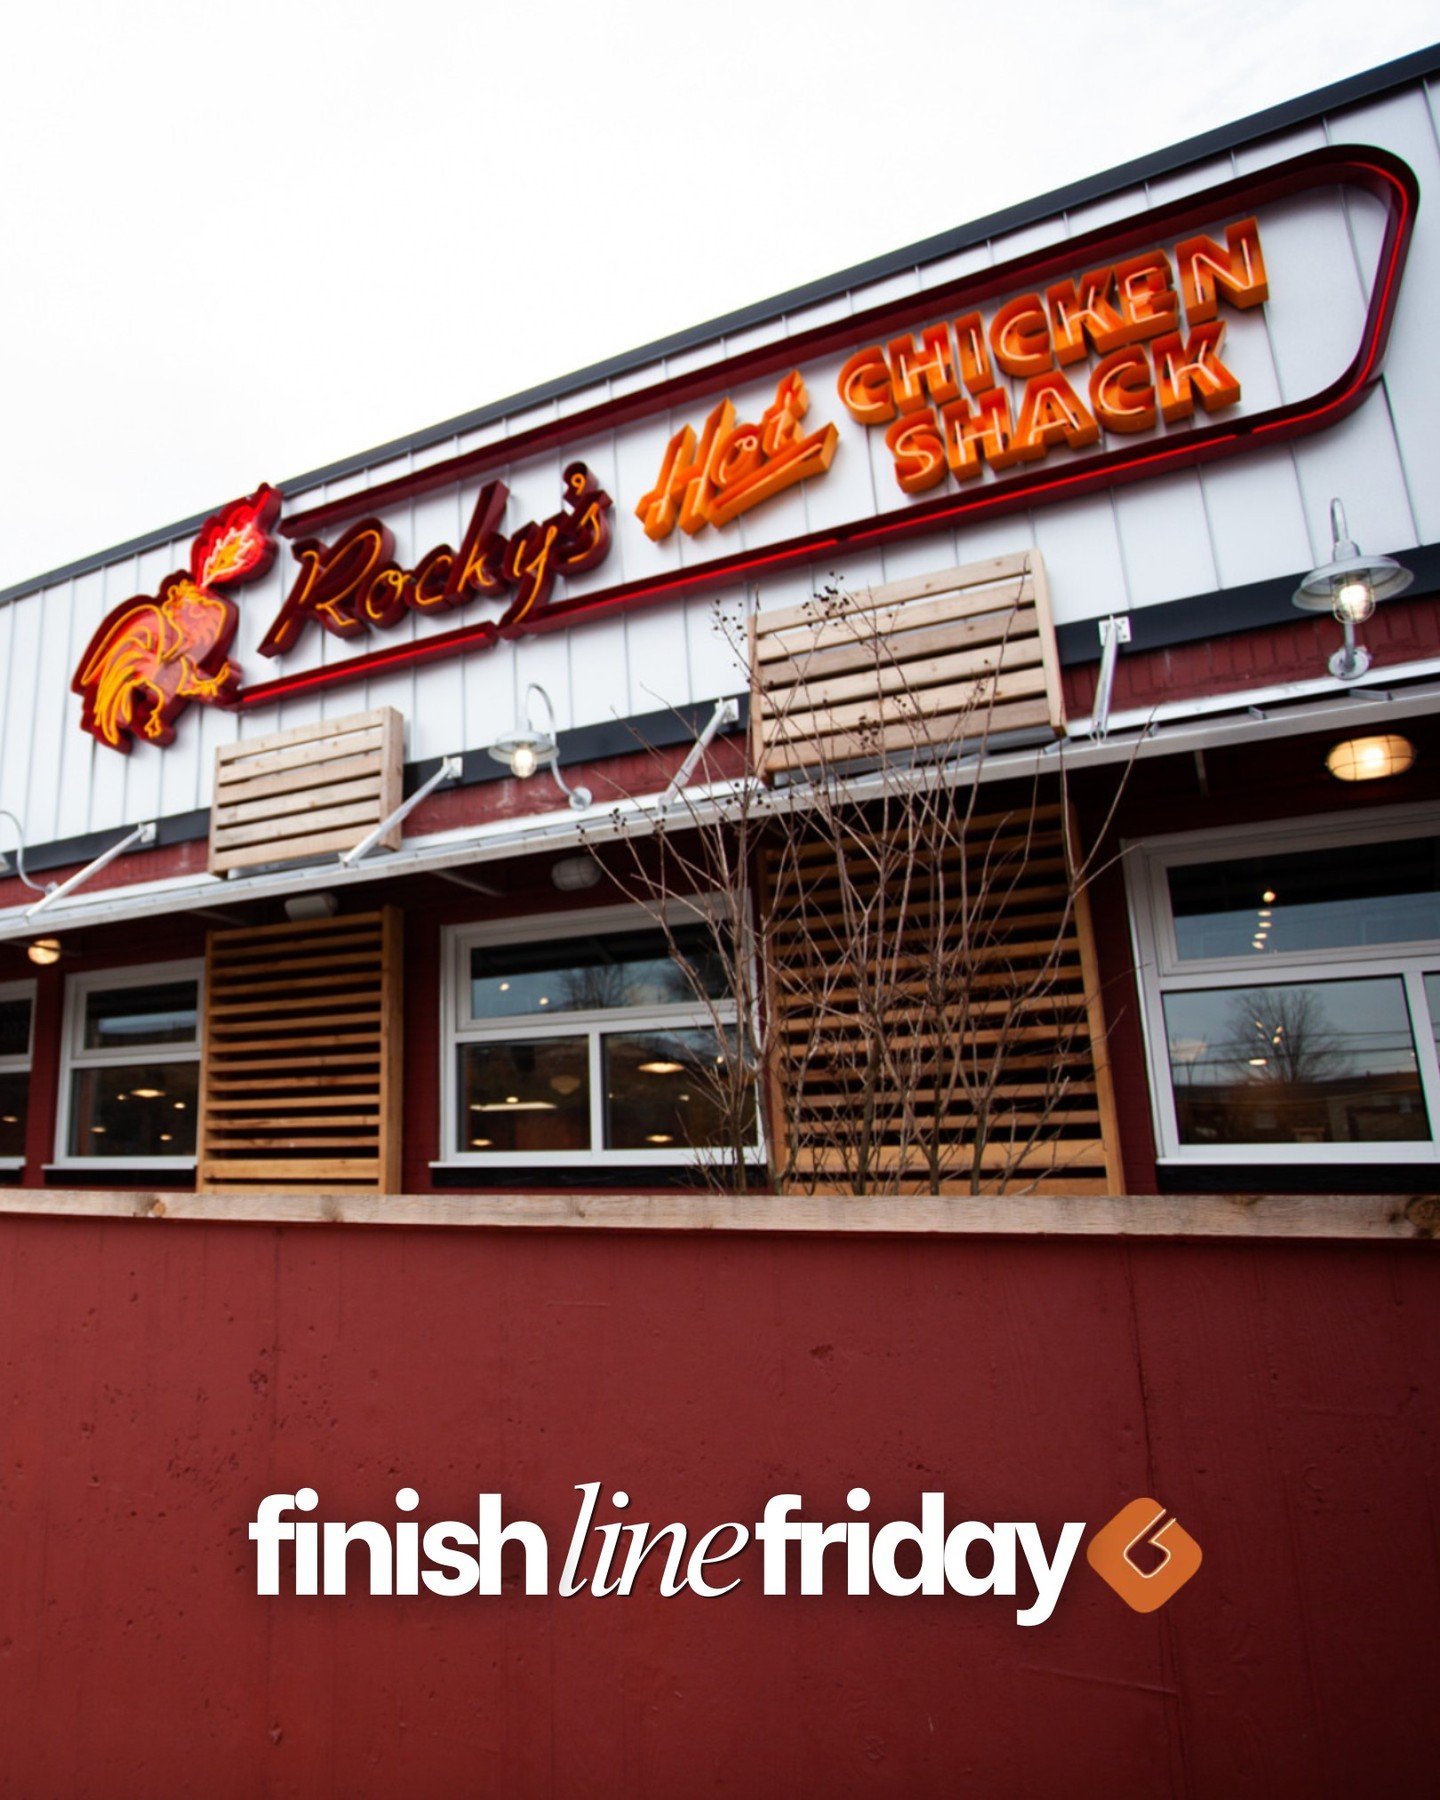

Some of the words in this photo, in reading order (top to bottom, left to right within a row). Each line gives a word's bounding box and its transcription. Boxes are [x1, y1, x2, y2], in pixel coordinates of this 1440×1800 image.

[837, 216, 1269, 426] CHICKEN
[885, 319, 1242, 495] SHACK
[258, 461, 613, 658] Rocky's
[635, 369, 840, 542] Hot
